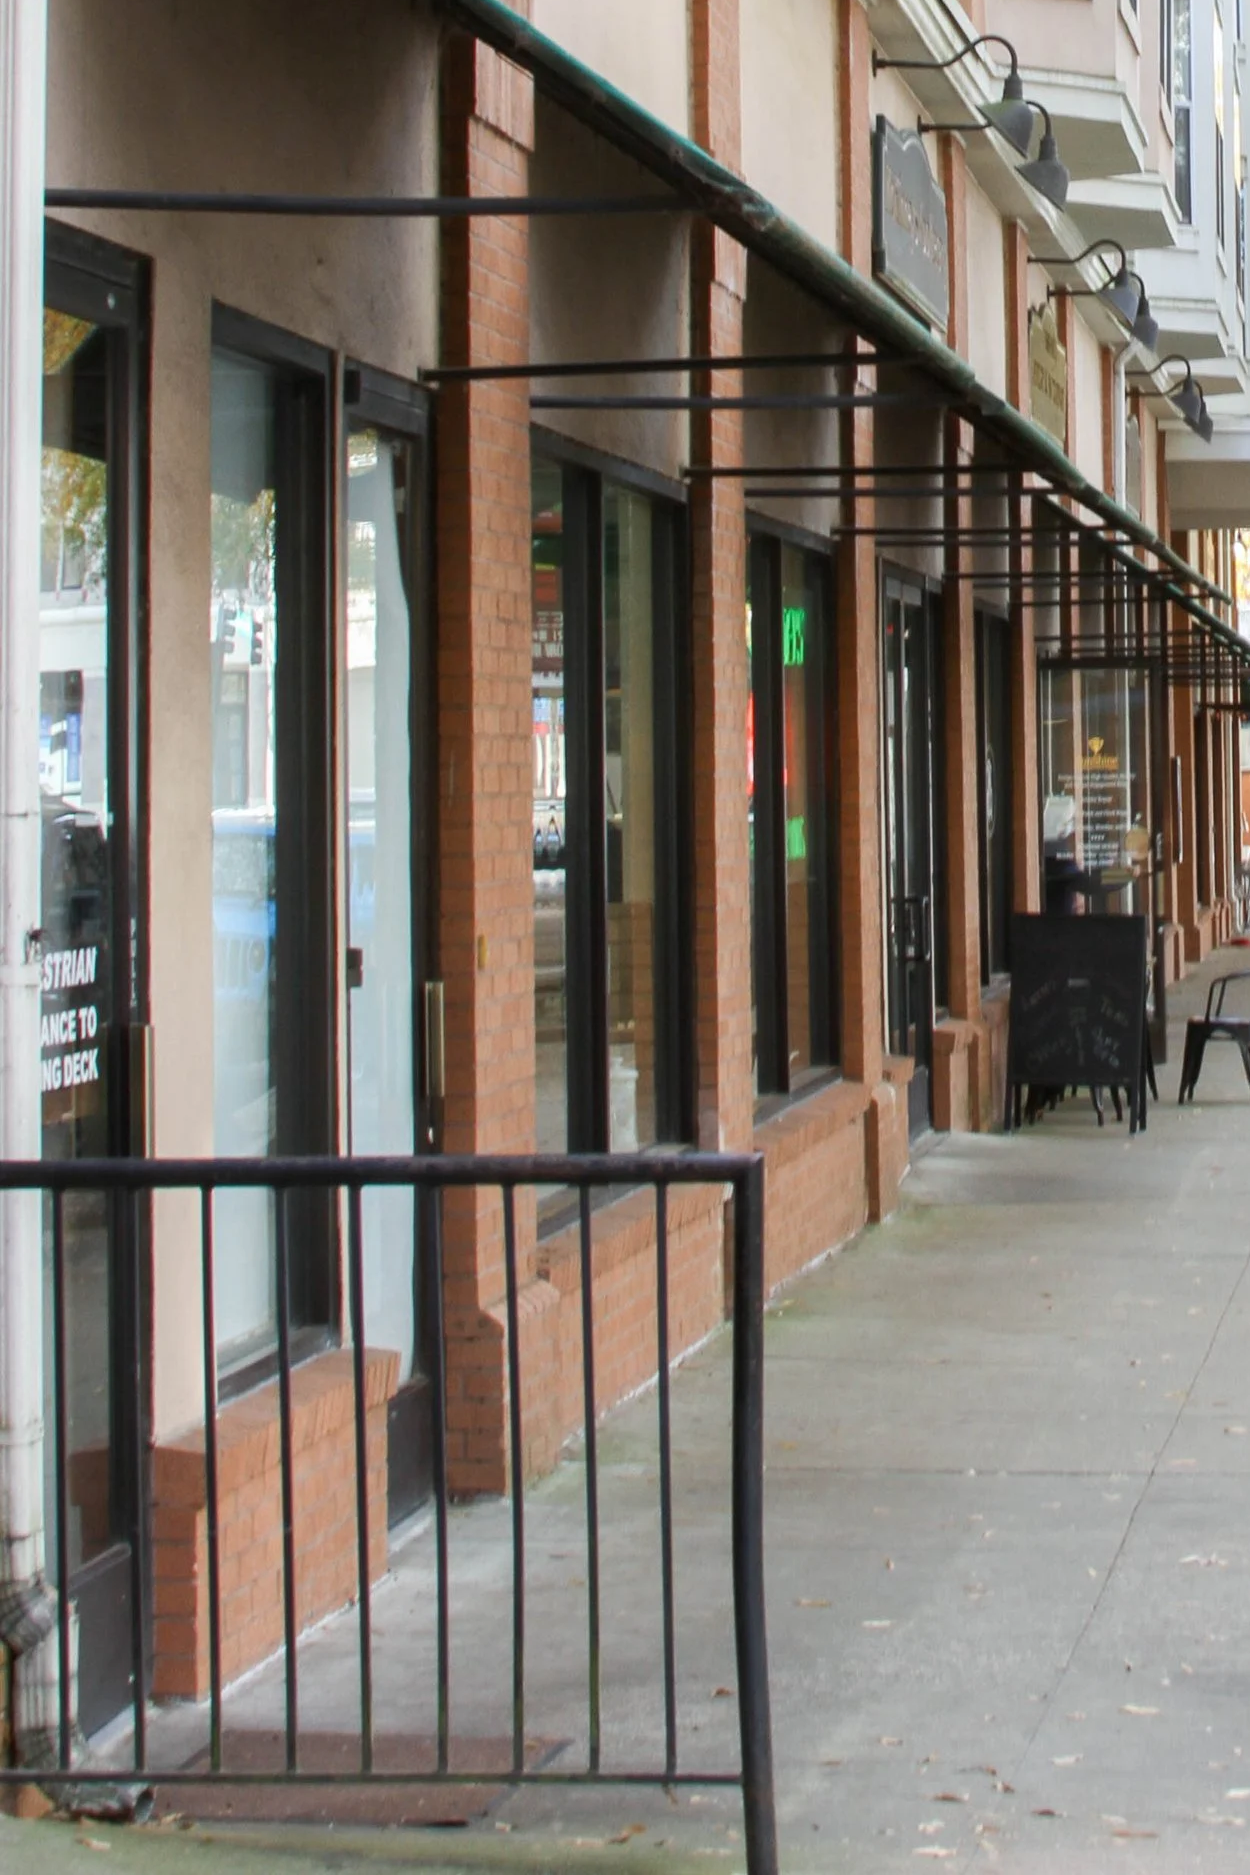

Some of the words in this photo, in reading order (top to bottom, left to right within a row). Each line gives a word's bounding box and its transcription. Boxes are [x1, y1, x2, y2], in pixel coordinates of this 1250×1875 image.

[41, 947, 97, 991] STRIAN
[78, 1006, 98, 1039] TO
[63, 1048, 99, 1087] DECK
